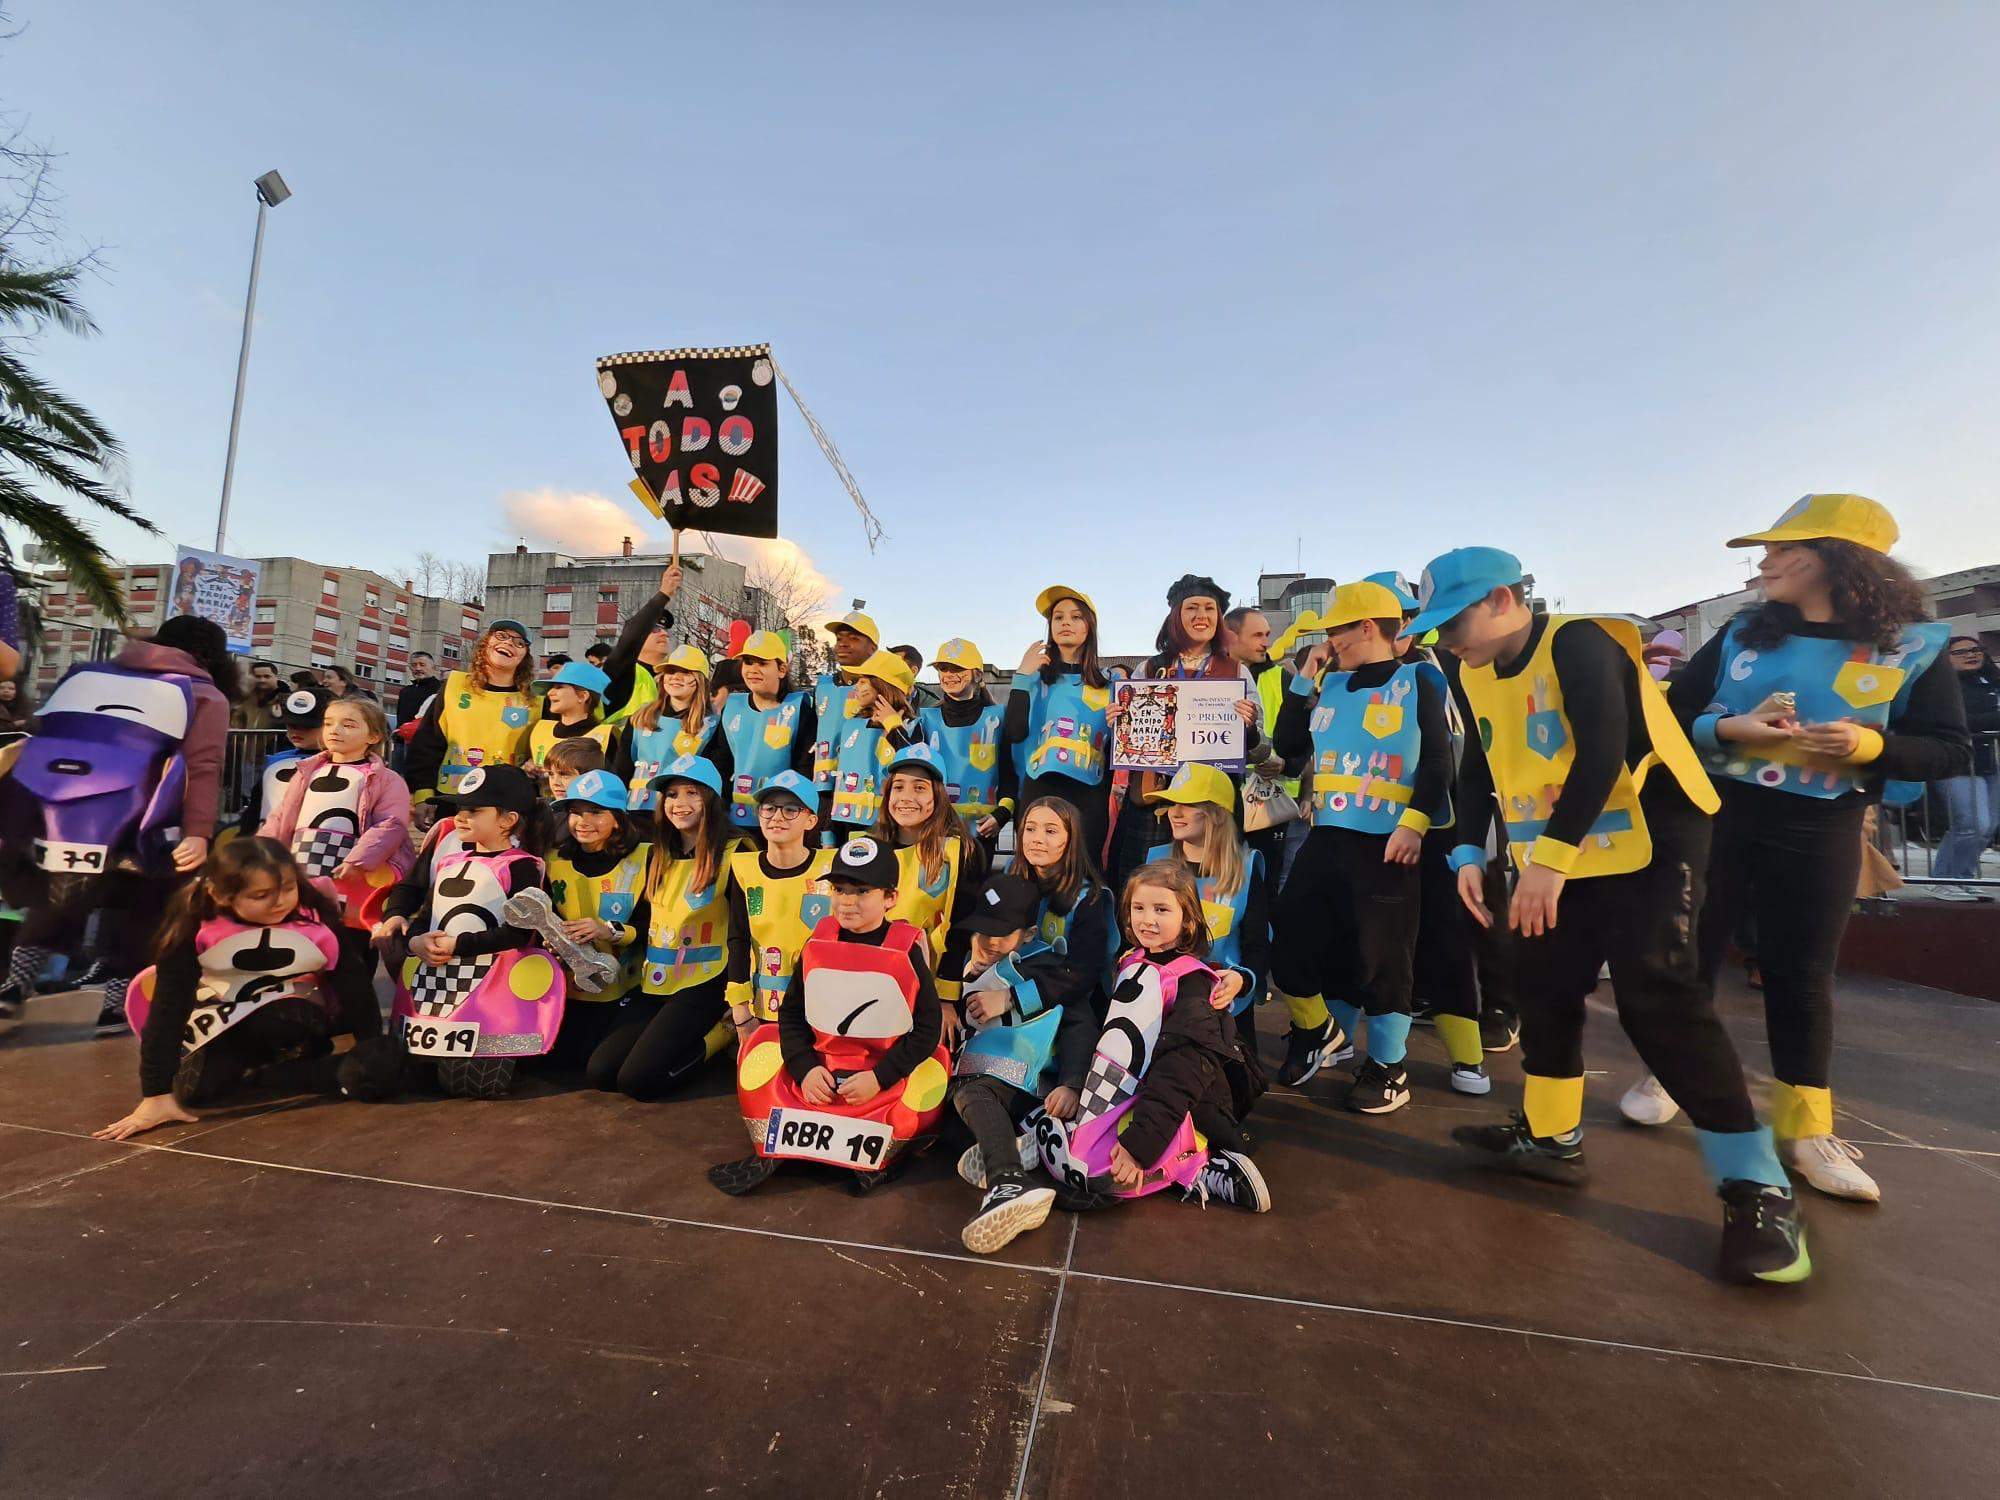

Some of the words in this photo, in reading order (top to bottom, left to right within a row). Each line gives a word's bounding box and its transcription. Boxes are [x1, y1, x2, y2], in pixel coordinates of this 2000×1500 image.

[664, 370, 694, 408] A
[622, 415, 754, 468] TODO
[1199, 713, 1238, 721] PREMIO
[1191, 730, 1232, 745] 150€
[444, 1029, 476, 1053] 19
[781, 1121, 835, 1151] RBR
[846, 1133, 885, 1165] 19
